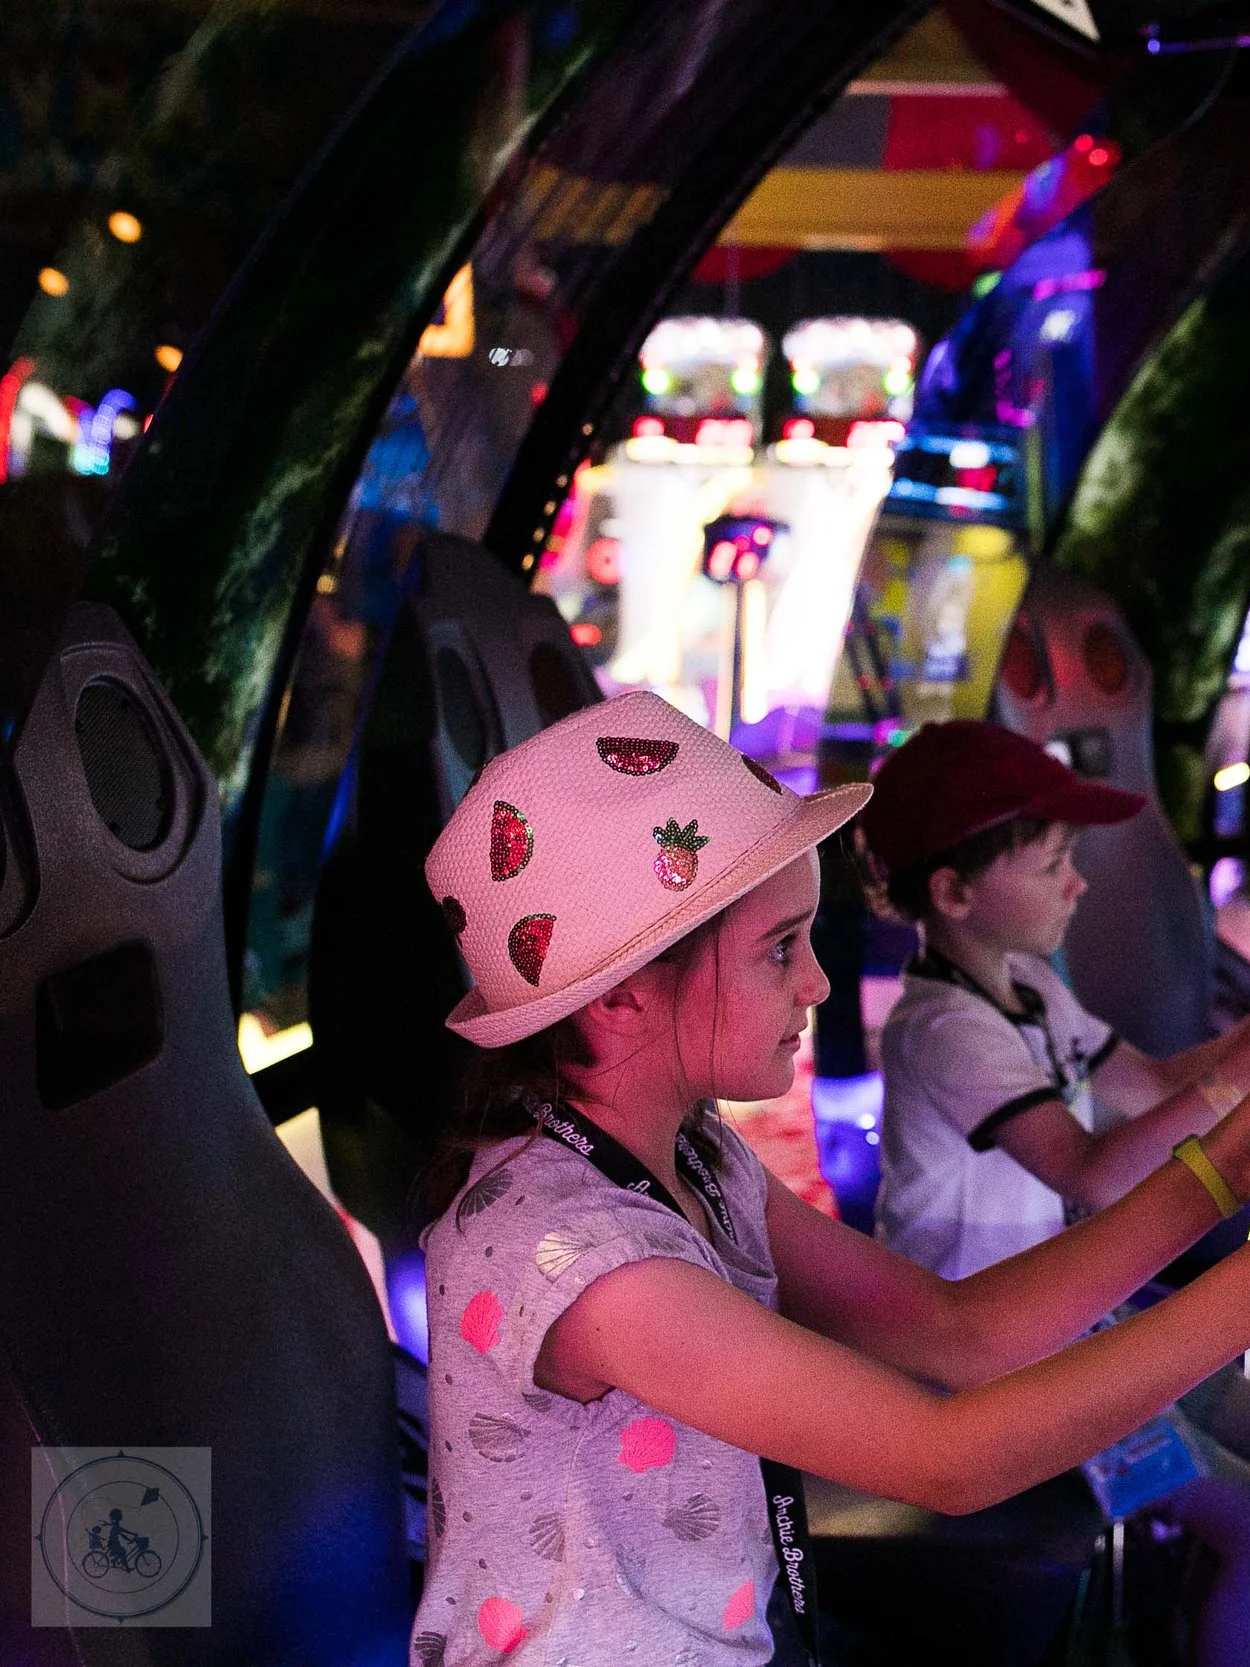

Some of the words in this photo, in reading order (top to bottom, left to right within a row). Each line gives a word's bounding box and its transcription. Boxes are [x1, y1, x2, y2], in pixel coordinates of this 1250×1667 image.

[534, 1103, 595, 1156] Brothers
[773, 1495, 794, 1546] Archie
[782, 1547, 805, 1614] Brothers
